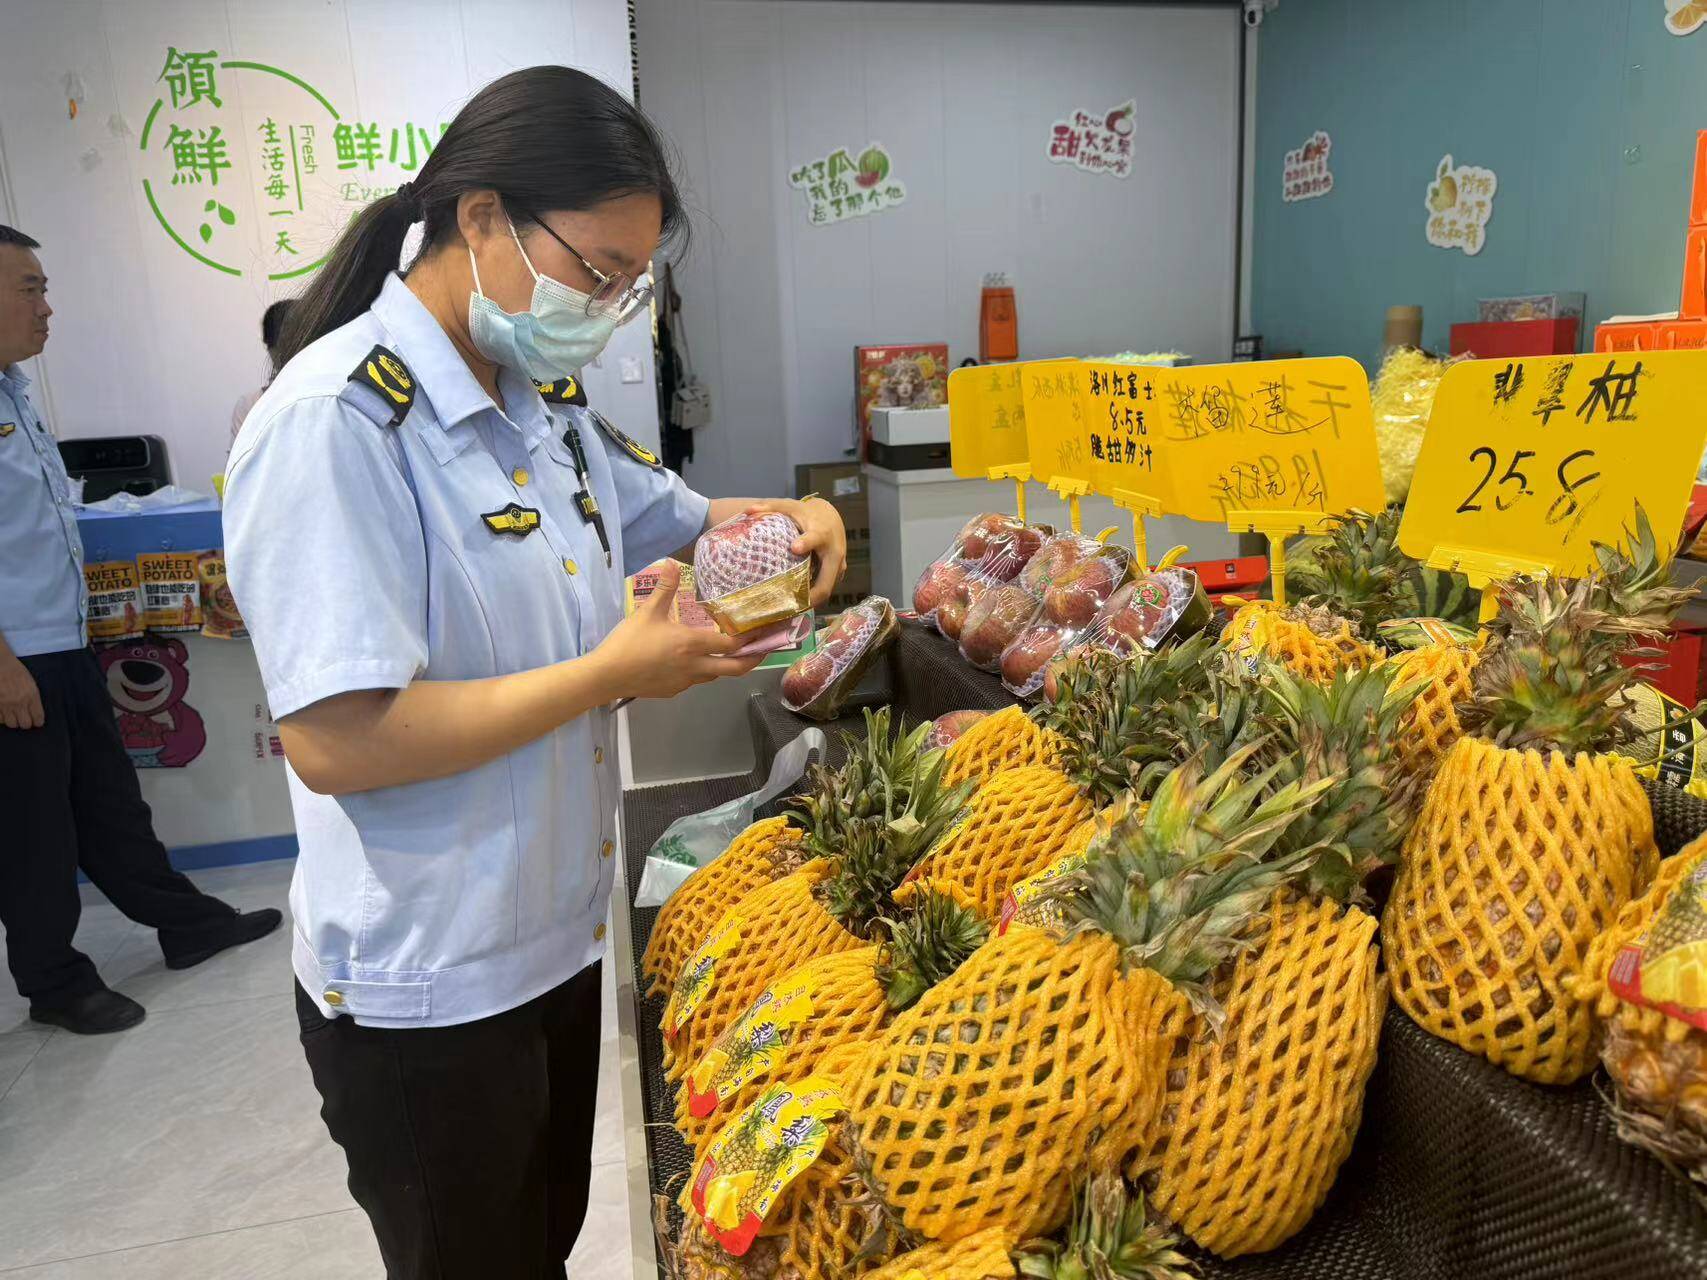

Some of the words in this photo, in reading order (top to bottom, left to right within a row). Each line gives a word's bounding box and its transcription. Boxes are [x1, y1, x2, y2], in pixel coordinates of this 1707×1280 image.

[156, 46, 232, 187] 領鮮
[300, 124, 319, 175] Fresh
[333, 122, 450, 171] 鲜小
[257, 117, 299, 256] 生活每一天
[1109, 401, 1147, 435] 8.5元
[84, 567, 130, 581] WEET
[143, 560, 193, 571] SWEET
[143, 570, 194, 581] POTATO
[87, 579, 132, 592] OTATO
